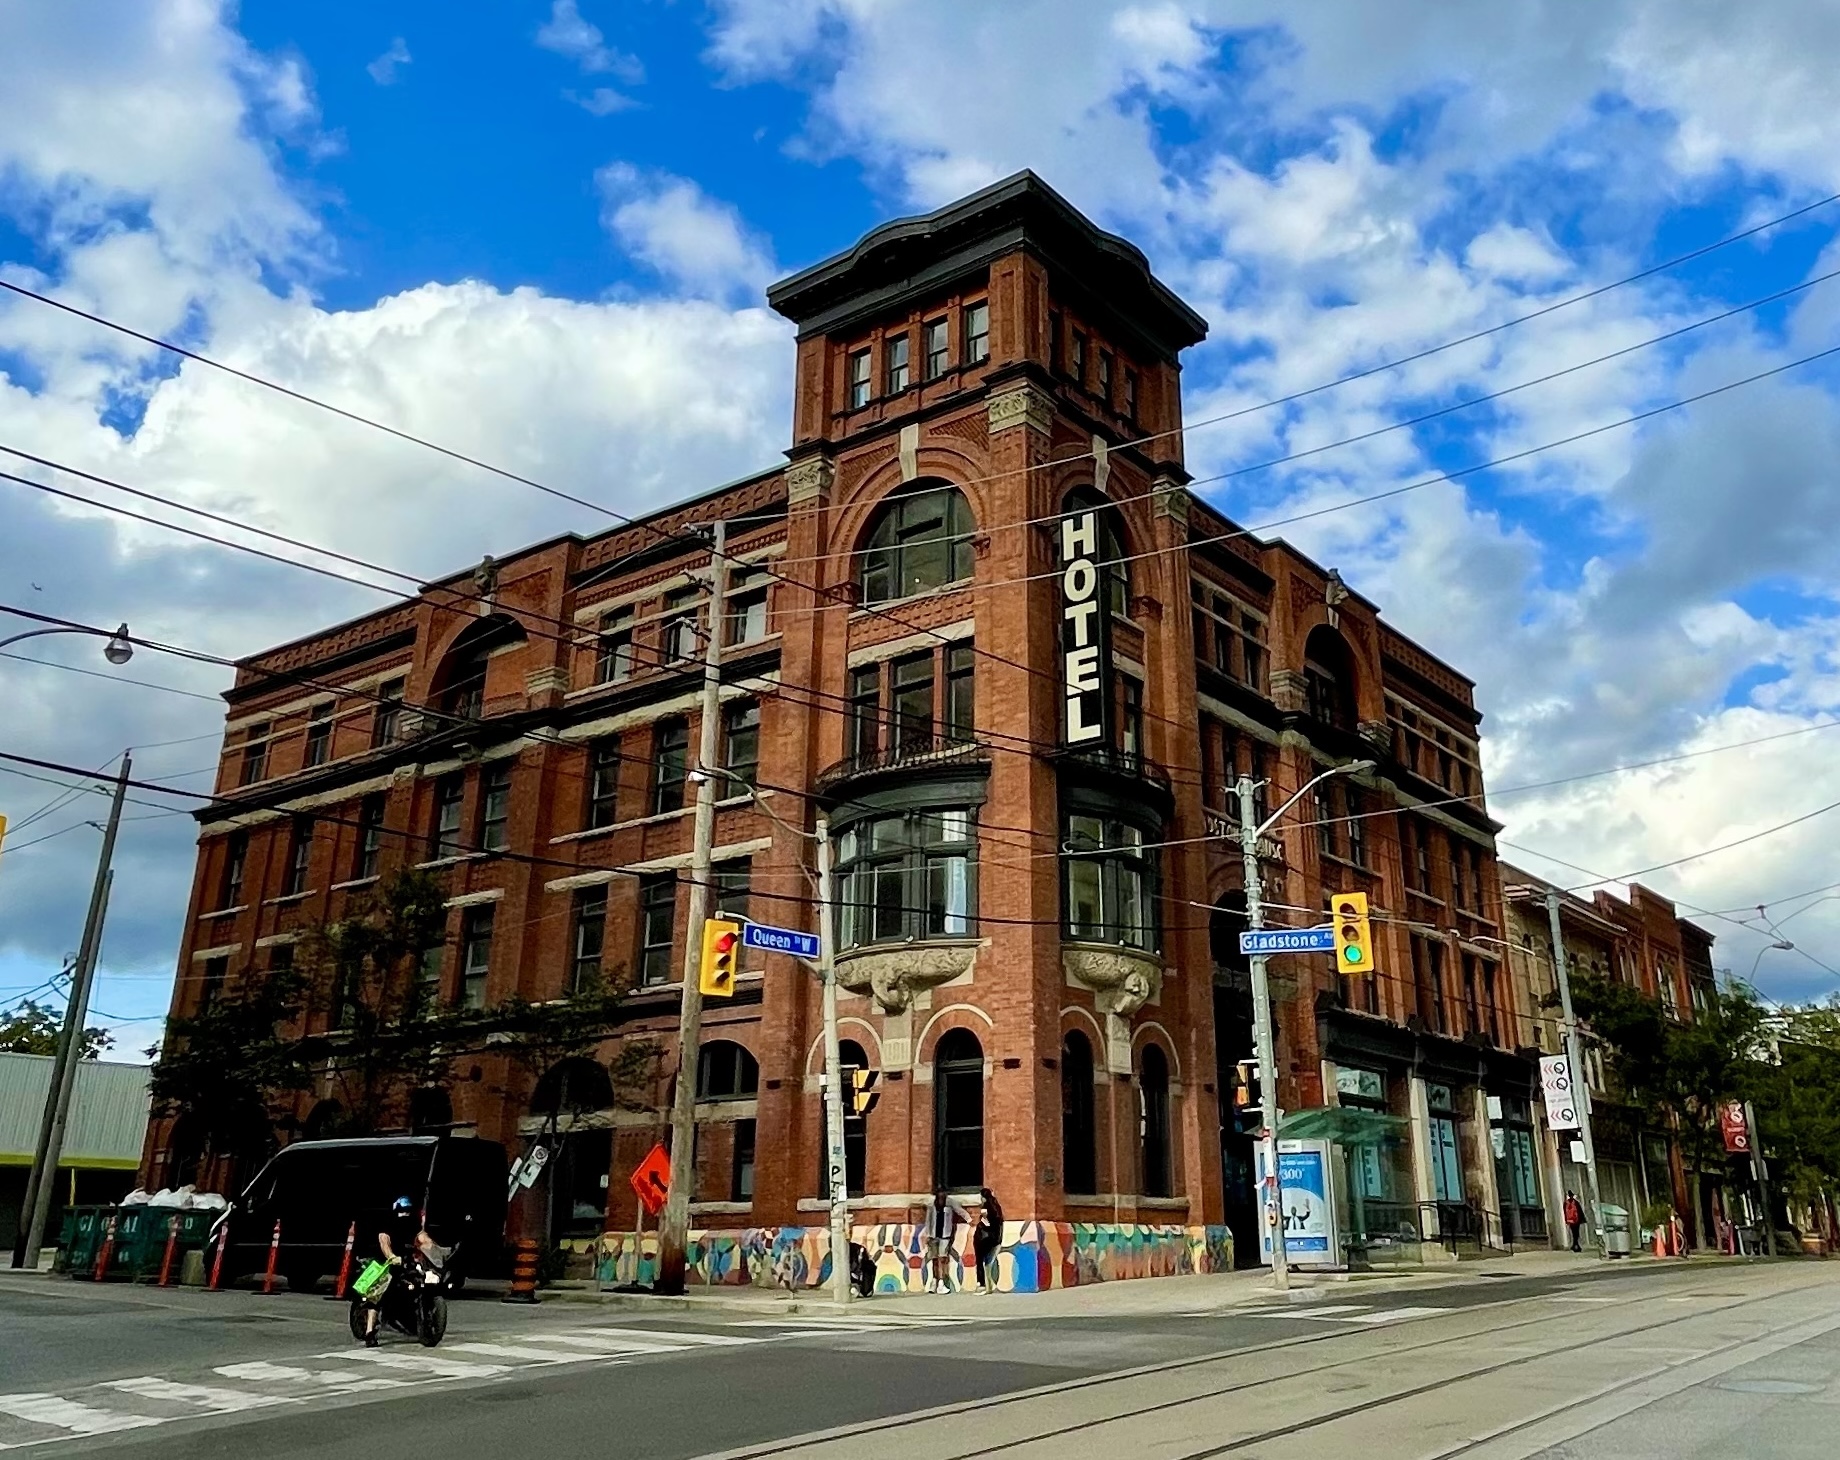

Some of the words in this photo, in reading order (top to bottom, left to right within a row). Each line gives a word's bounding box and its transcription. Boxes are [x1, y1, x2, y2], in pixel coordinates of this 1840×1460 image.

[1062, 512, 1101, 743] HOTEL
[753, 928, 791, 949] Queen
[801, 937, 812, 952] W
[1243, 934, 1319, 950] Gladstone
